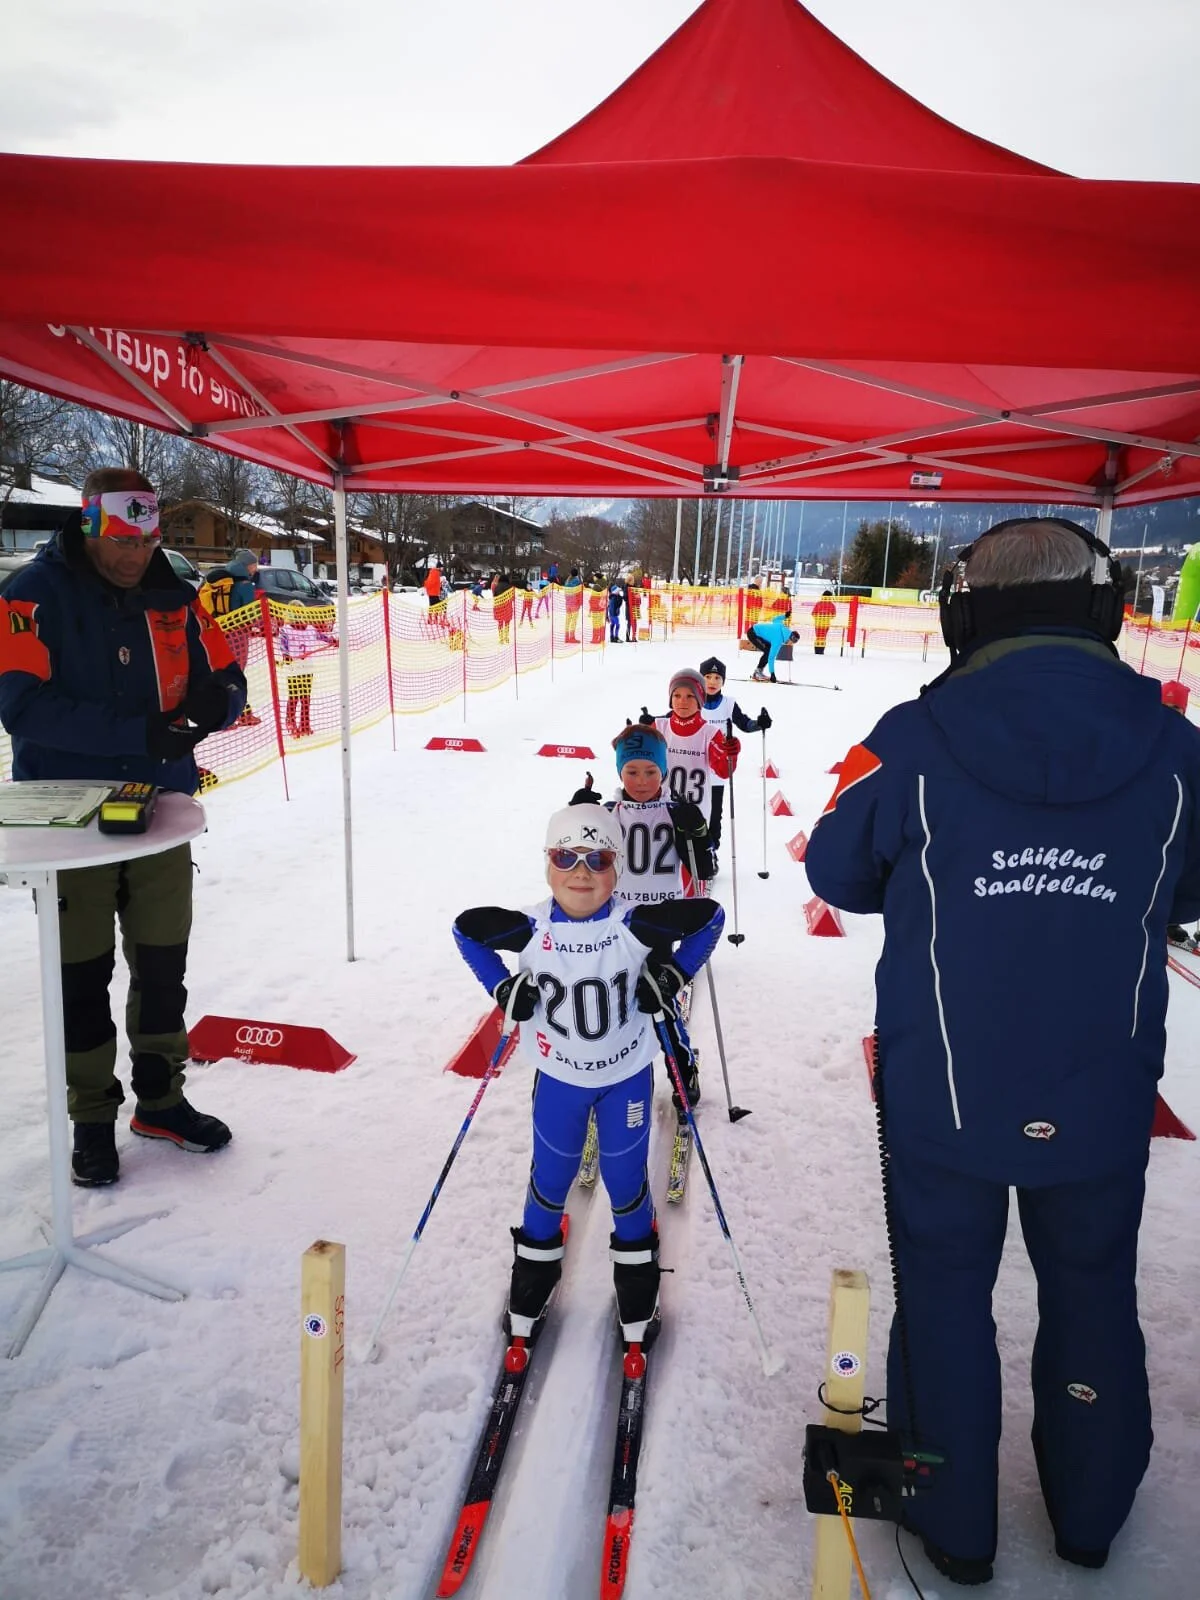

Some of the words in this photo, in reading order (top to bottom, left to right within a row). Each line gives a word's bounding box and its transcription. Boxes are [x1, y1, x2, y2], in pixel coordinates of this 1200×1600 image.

[667, 747, 701, 757] SALZBURG
[667, 765, 706, 805] 03
[620, 822, 677, 876] 02
[992, 847, 1107, 871] Schiklub
[973, 873, 1117, 903] Saalfelden
[536, 968, 630, 1042] 201
[452, 1525, 475, 1574] ATOMIC
[608, 1534, 625, 1585] ATOMIC
